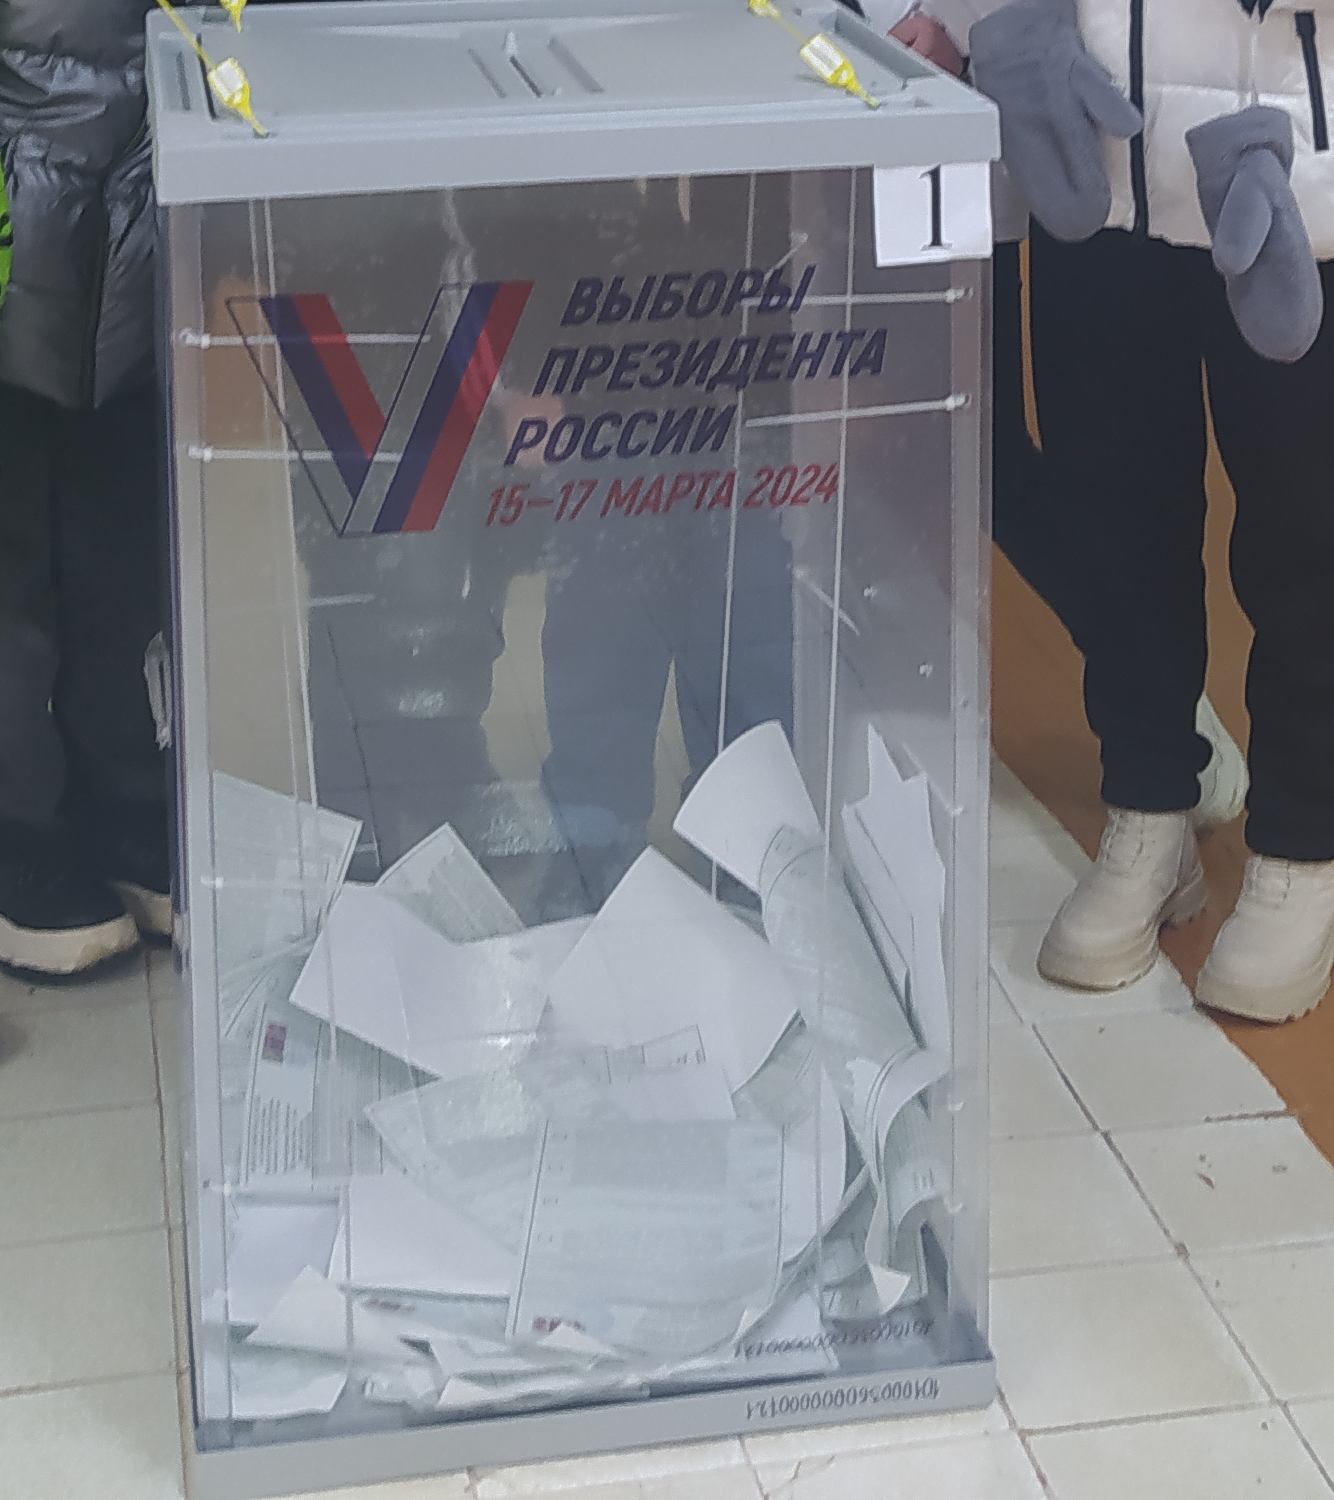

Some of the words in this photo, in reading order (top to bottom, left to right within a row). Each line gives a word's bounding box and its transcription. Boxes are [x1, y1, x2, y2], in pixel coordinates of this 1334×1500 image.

[918, 163, 953, 252] 1
[560, 265, 817, 327] ВЫБОРЫ
[533, 327, 887, 397] ПРЕЗИДЕНТА
[503, 403, 737, 468] РОССИИ
[599, 470, 737, 518] МАРТА
[742, 462, 840, 509] 2024
